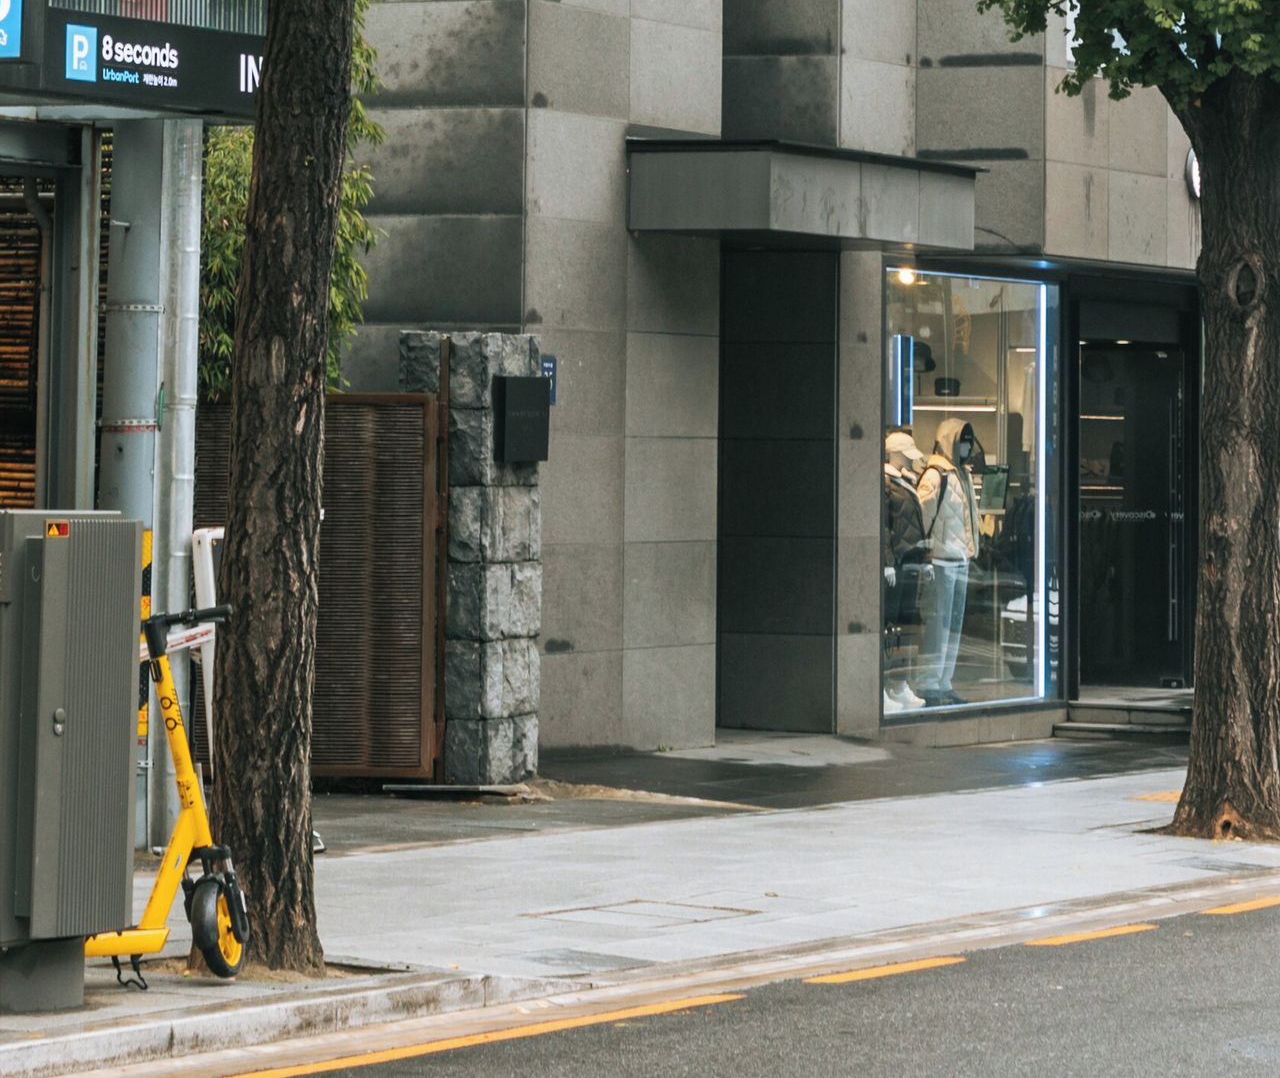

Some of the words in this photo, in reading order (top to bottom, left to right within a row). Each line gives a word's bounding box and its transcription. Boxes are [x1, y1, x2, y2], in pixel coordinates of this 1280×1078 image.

[73, 34, 88, 70] P
[102, 35, 113, 60] 8
[114, 43, 179, 69] seconds
[102, 68, 139, 84] UrbanPort
[164, 77, 178, 88] 2.0m
